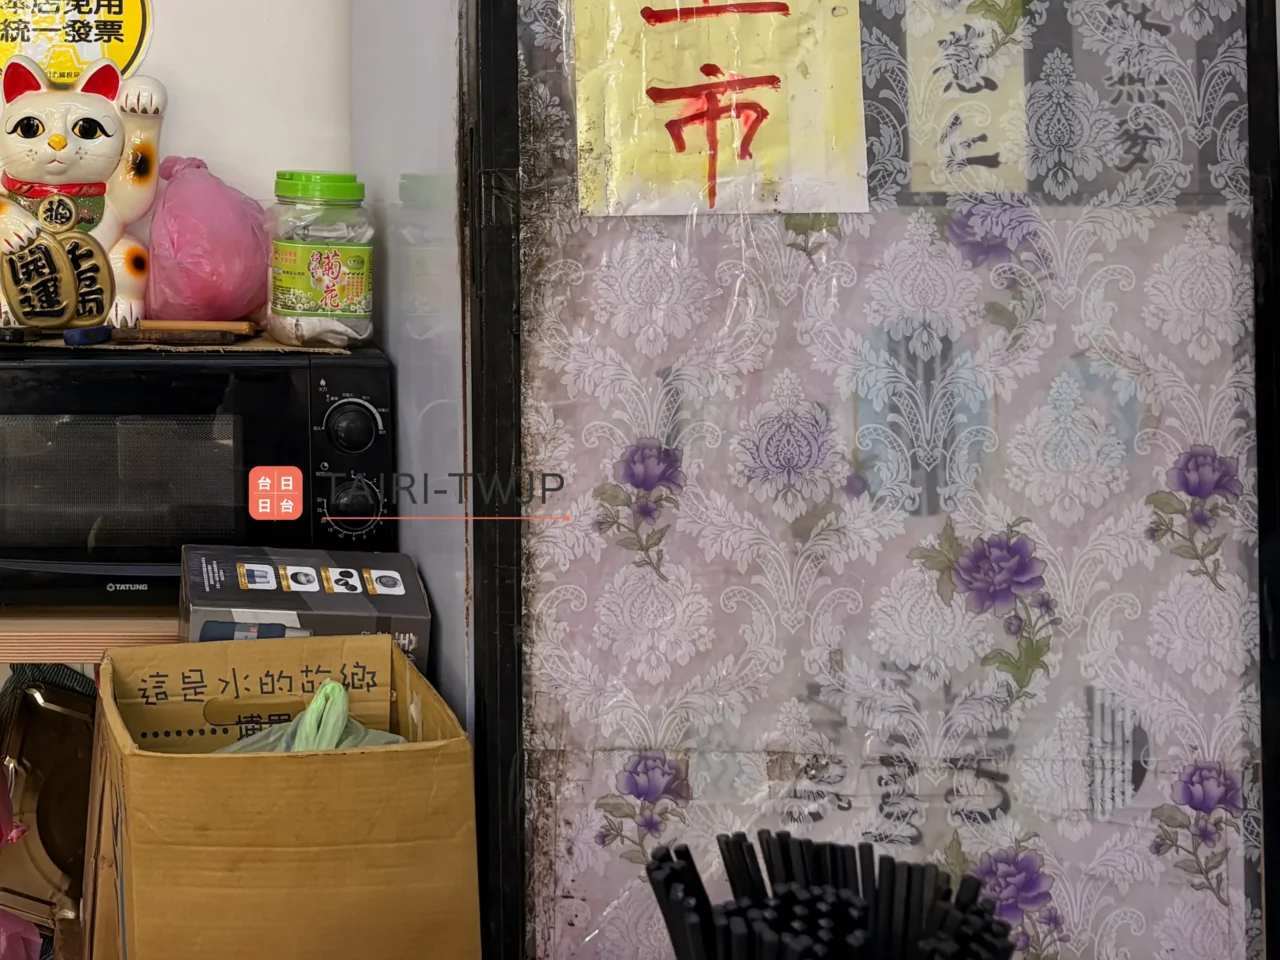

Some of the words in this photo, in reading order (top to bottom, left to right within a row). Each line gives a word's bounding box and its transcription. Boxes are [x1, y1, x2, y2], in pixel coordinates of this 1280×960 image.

[0, 19, 124, 43] 統一發票
[9, 243, 66, 317] 開運
[320, 249, 341, 308] 菊花
[137, 662, 377, 705] 這是水的故鄉
